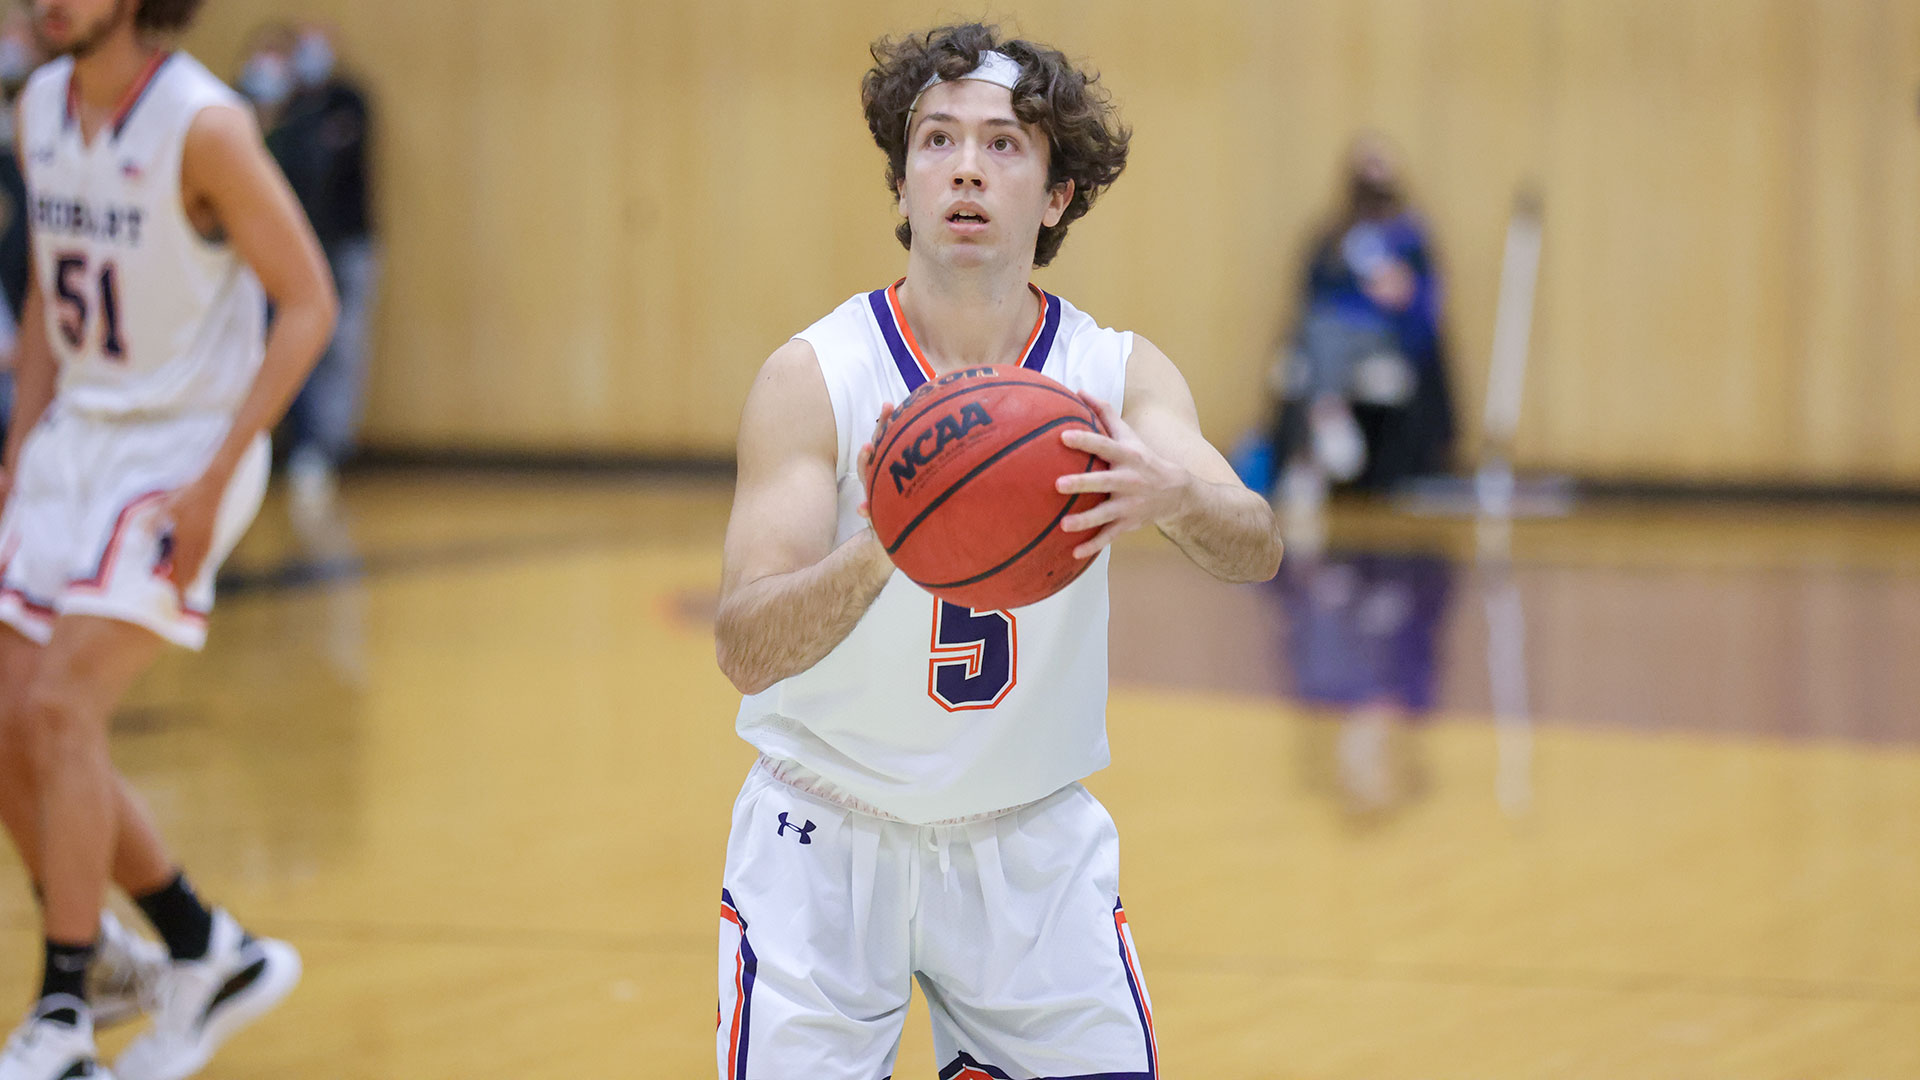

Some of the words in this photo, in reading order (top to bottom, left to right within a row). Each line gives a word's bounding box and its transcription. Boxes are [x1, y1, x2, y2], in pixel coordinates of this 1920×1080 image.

[55, 252, 127, 362] 51
[889, 401, 993, 495] NCAA
[928, 595, 1018, 712] 5
